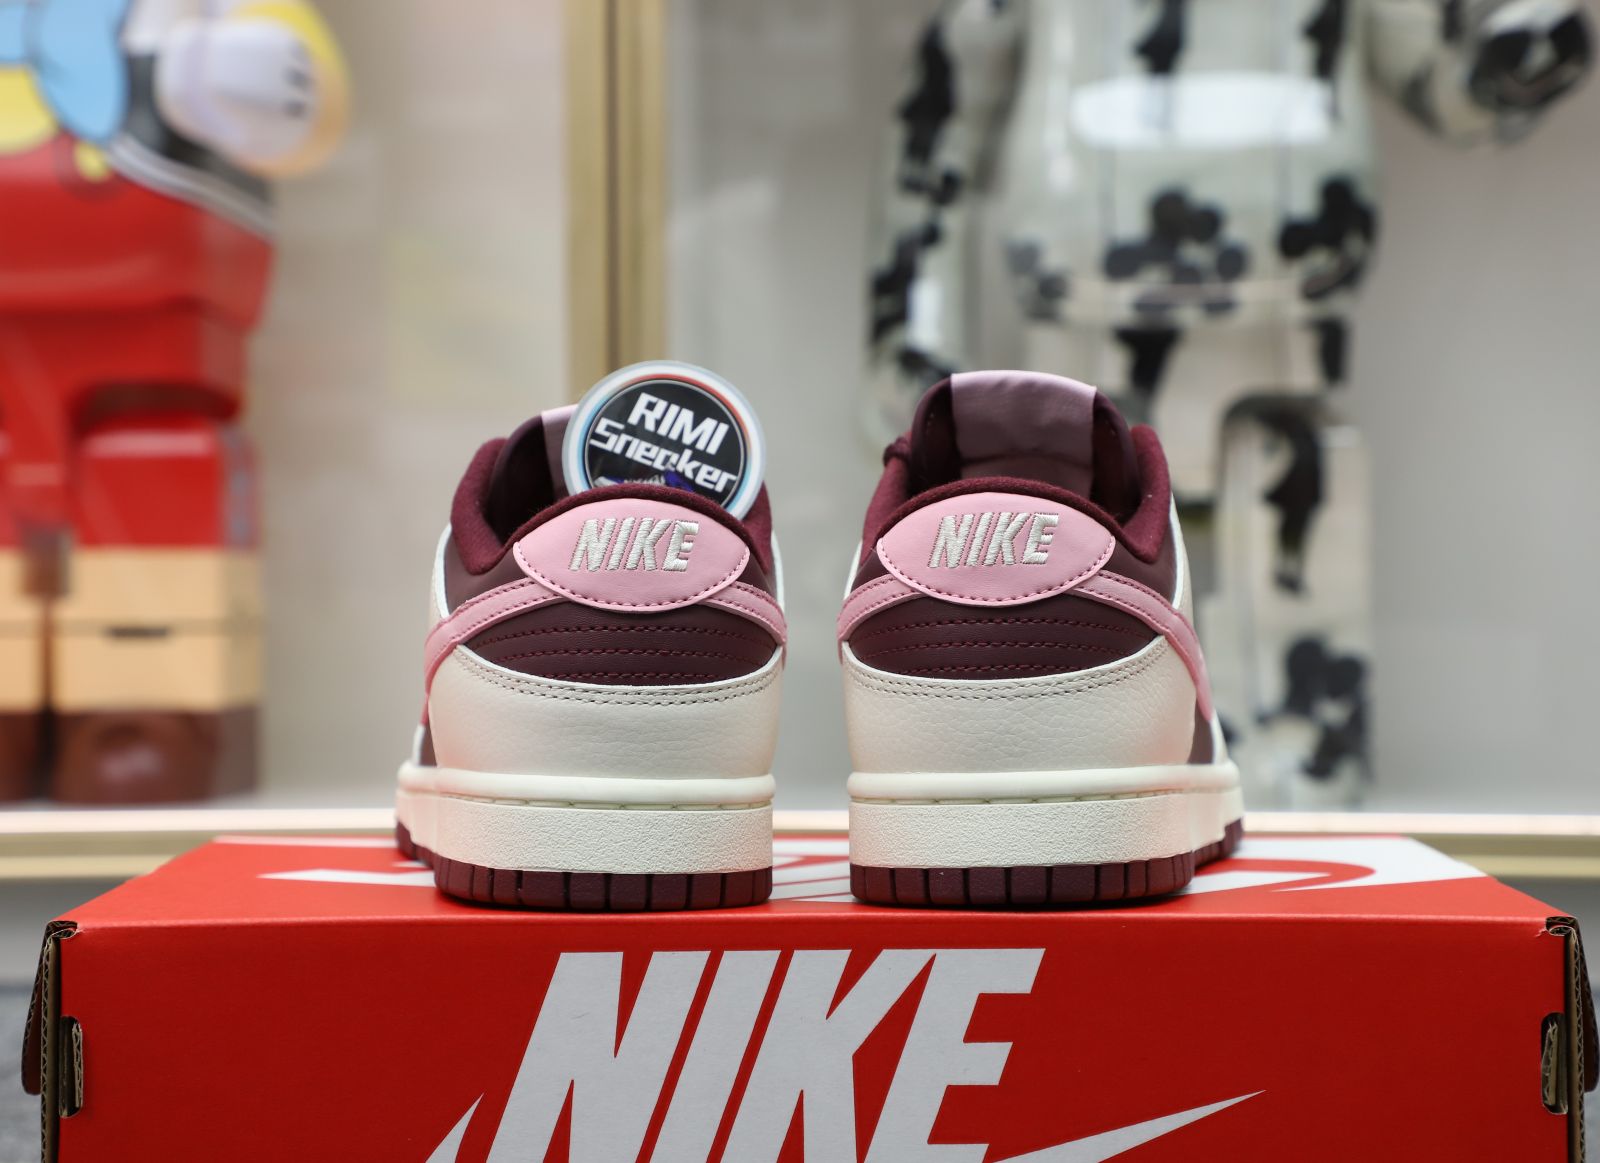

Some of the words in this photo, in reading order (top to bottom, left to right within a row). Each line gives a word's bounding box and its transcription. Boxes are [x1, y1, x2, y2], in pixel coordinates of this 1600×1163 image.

[589, 417, 737, 493] Sneaker
[627, 392, 730, 456] RIMI
[569, 516, 700, 572] NIKE
[930, 511, 1060, 569] NIKE
[485, 948, 1046, 1163] NIKE
